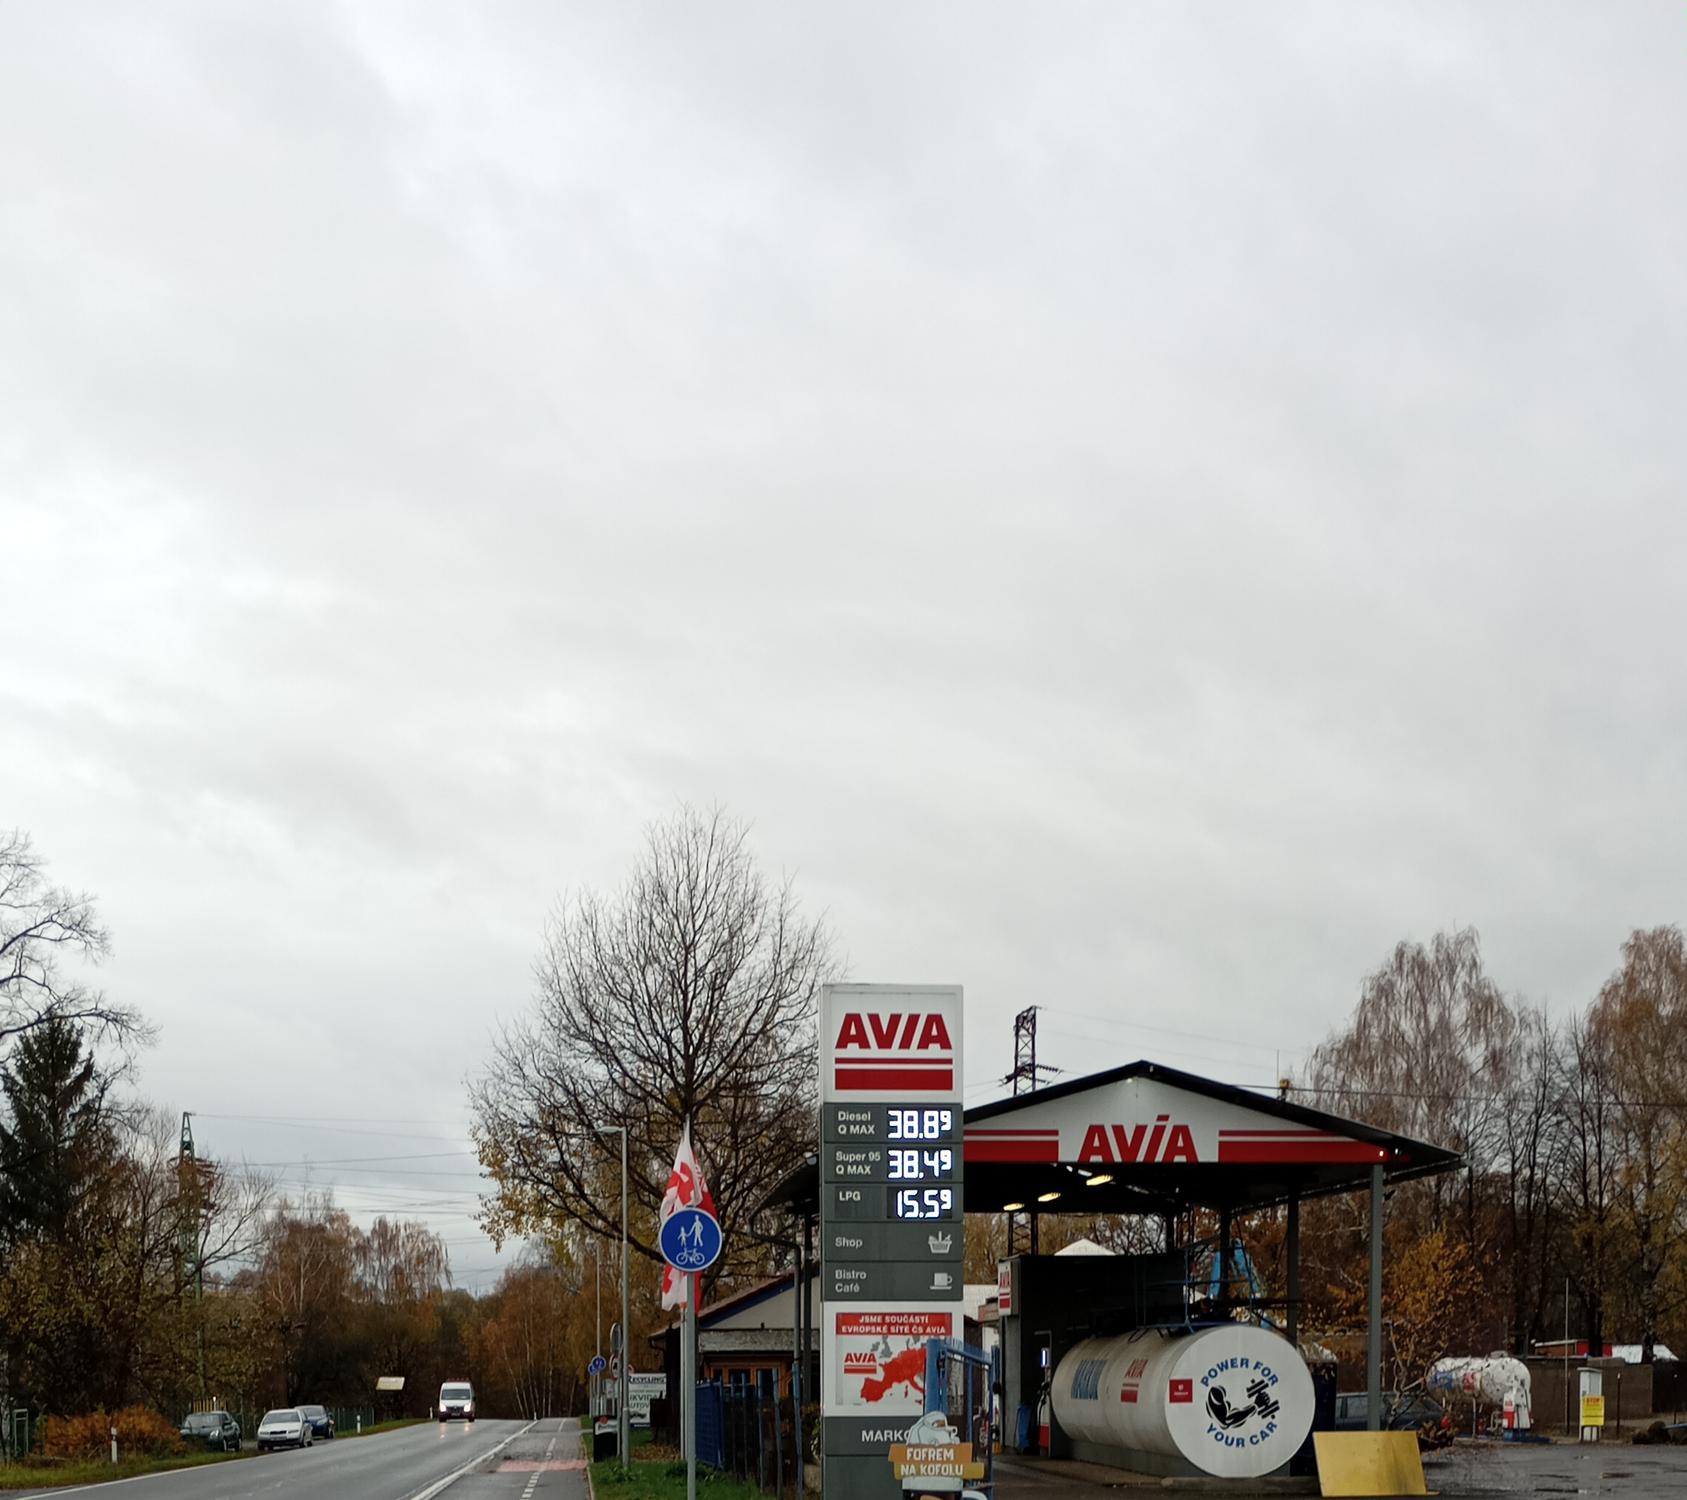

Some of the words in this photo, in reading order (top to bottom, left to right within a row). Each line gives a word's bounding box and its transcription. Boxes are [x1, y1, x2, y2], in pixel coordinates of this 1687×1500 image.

[834, 1013, 953, 1050] AVIA
[837, 1110, 871, 1122] Diesel
[837, 1124, 848, 1135] Q
[850, 1124, 875, 1135] MAX
[1077, 1114, 1199, 1162] AVIA
[835, 1151, 866, 1164] Super
[868, 1151, 881, 1162] 95
[835, 1165, 846, 1176] Q
[847, 1165, 871, 1175] MAX
[839, 1191, 861, 1201] LPG
[835, 1237, 863, 1249] Shop
[835, 1269, 867, 1279] Bistro
[835, 1282, 860, 1293] Café
[859, 1315, 882, 1323] JSME
[841, 1325, 887, 1333] EVROPSKÉ
[925, 1326, 946, 1334] AVIA
[844, 1353, 877, 1363] AVIA
[1200, 1357, 1250, 1387] POWER
[1253, 1361, 1279, 1386] FOR
[1206, 1422, 1245, 1448] YOUR
[1249, 1421, 1278, 1445] CAR
[907, 1448, 954, 1461] FOFREM
[900, 1464, 916, 1476] NA
[920, 1464, 964, 1476] KOFOLU
